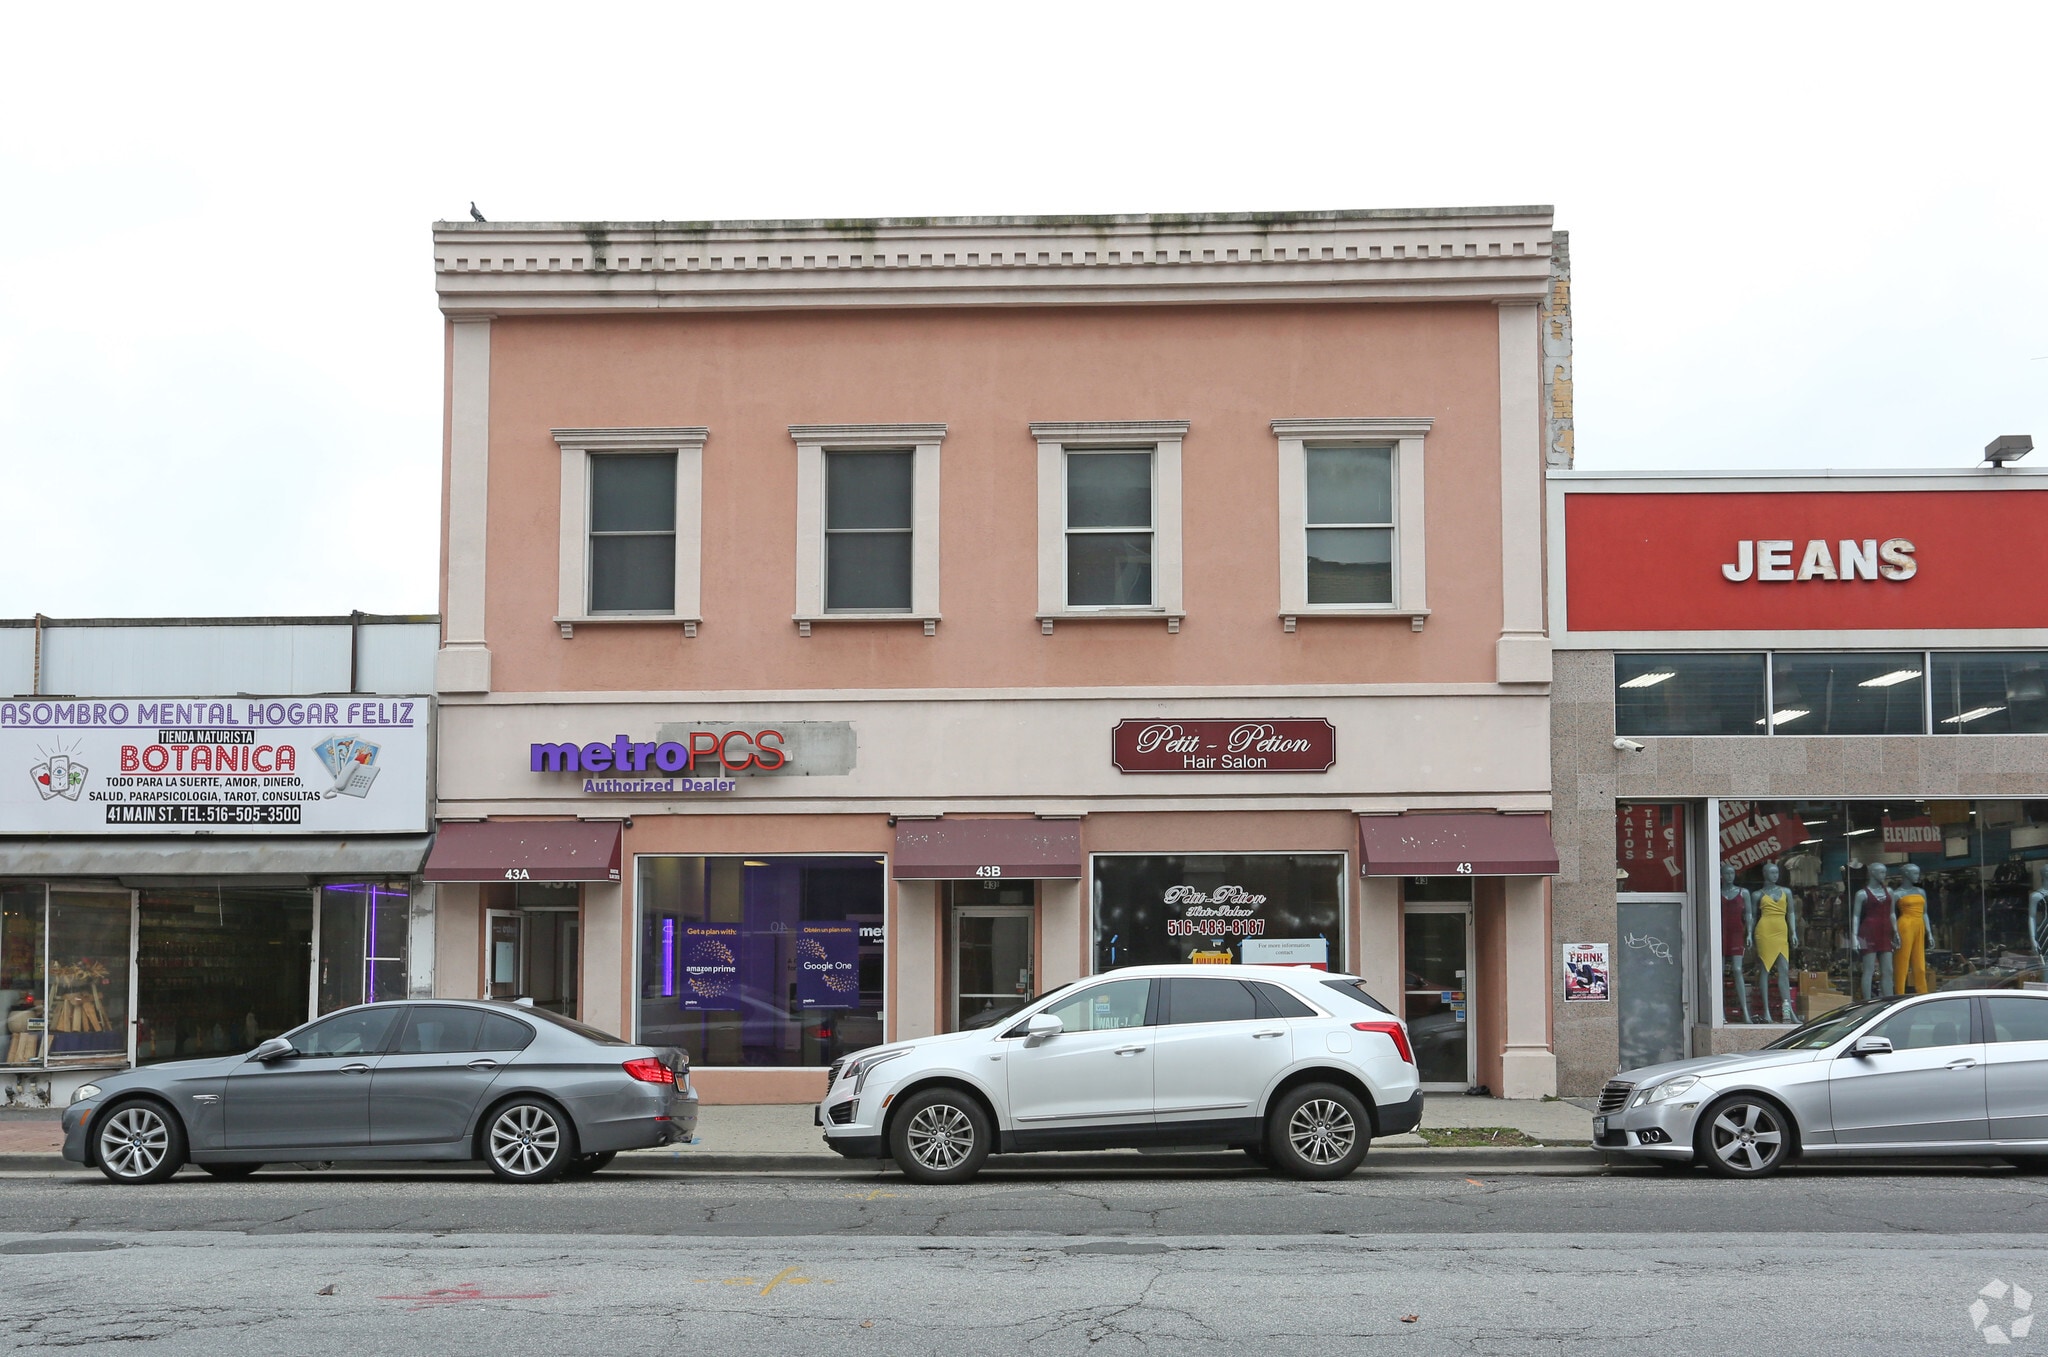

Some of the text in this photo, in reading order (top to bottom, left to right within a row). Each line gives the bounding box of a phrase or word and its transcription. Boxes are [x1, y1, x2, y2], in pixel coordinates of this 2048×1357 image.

[1721, 537, 1918, 582] JEANS
[1, 702, 414, 725] ASOMBRO MENTAL HOGAR FELIZ
[160, 730, 254, 743] TIENDA NATURISTA
[1136, 724, 1200, 753] Petit
[1227, 723, 1311, 753] Petion
[530, 730, 786, 772] metroPCS
[120, 745, 296, 772] BOTANICA
[1183, 755, 1267, 769] Hair Salon
[106, 777, 304, 788] TODO PARA LA SUERTE, AMOR, DINERO,
[583, 778, 736, 792] Authorized Dealer
[89, 791, 321, 803] SALUD, PARAPSICOLOGIA, TAROT, CONSULTAS
[107, 806, 121, 822] 41
[123, 806, 156, 822] MAIN
[158, 806, 177, 822] ST.
[1644, 808, 1655, 860] TENIS
[1883, 826, 1942, 843] ELEVATOR
[505, 868, 530, 880] 43A
[976, 866, 1001, 877] 43B
[1456, 863, 1473, 874] 43
[706, 928, 720, 936] plan
[1167, 919, 1265, 936] 516-483-8187
[1570, 952, 1603, 963] FRANK
[686, 965, 736, 974] amazon prime
[803, 961, 834, 971] Google
[835, 961, 852, 970] One
